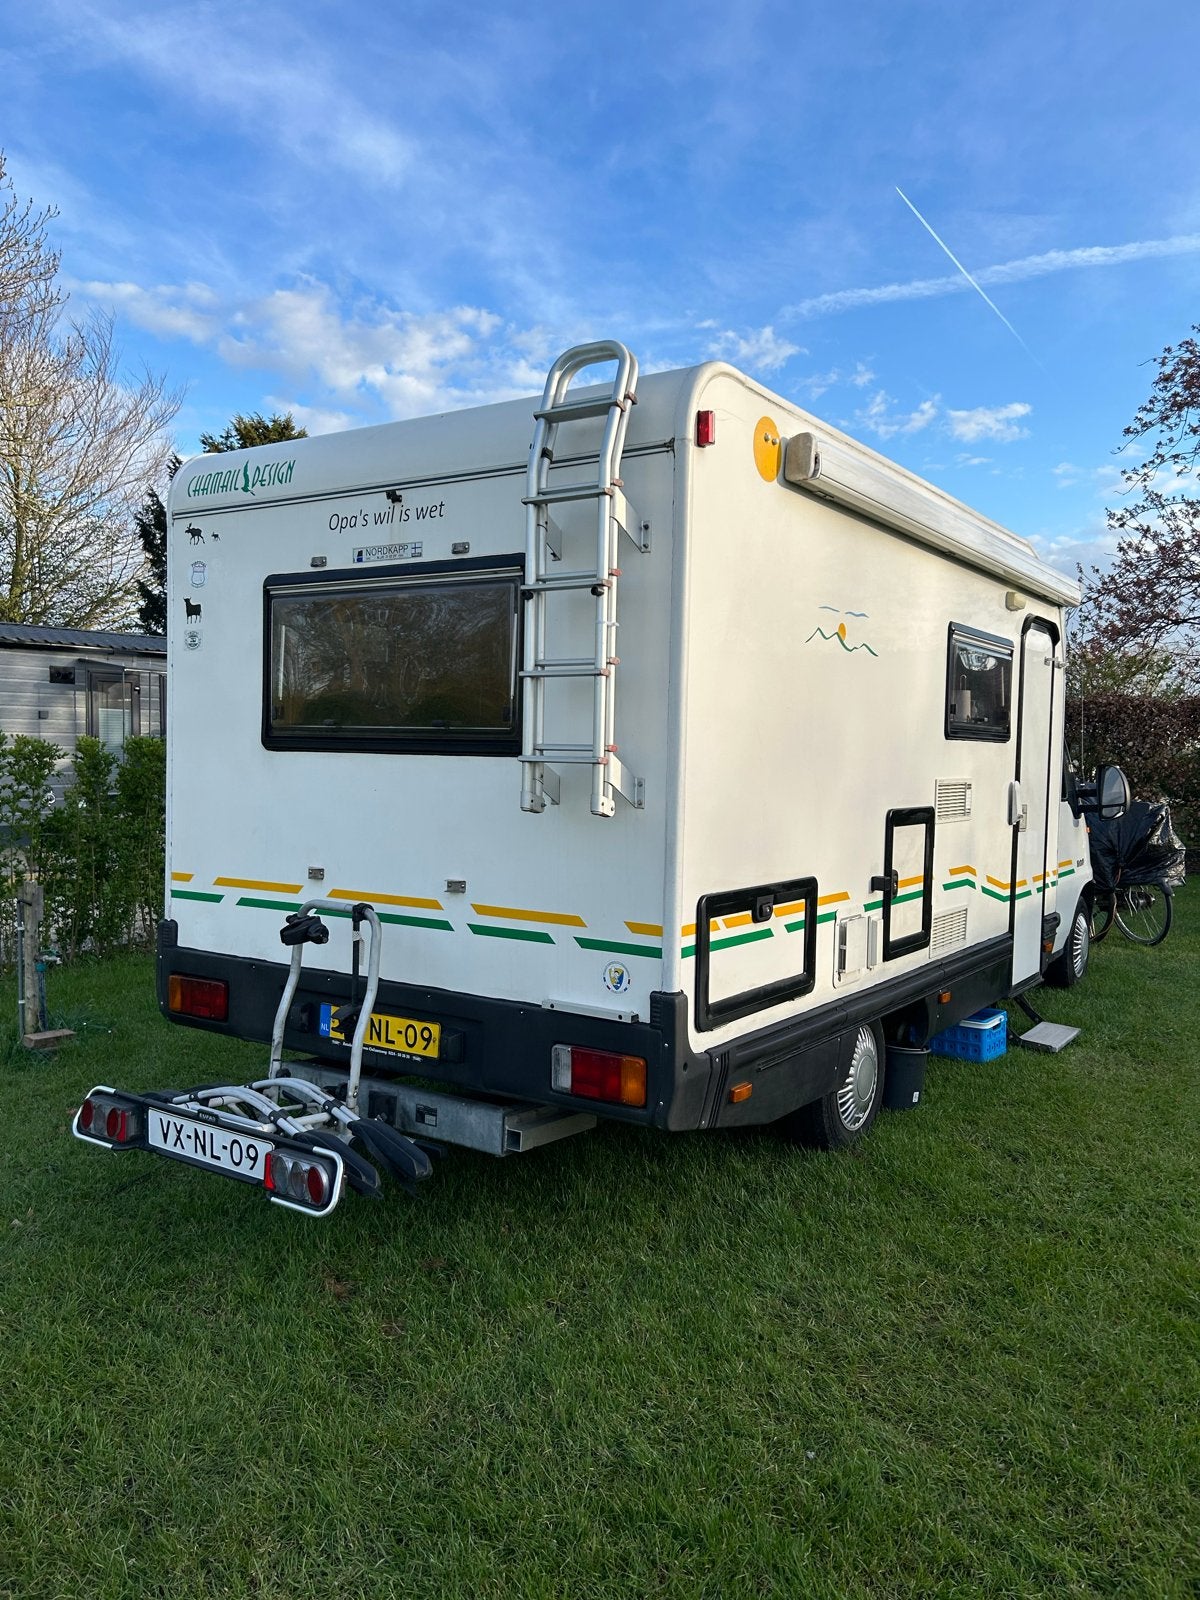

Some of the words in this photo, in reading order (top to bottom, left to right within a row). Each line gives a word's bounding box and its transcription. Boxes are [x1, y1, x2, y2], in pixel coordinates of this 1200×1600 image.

[187, 468, 241, 498] CHAMAIL
[251, 459, 297, 489] DESIGN
[328, 508, 369, 534] Opa's
[373, 504, 396, 526] wil
[399, 504, 411, 523] is
[415, 500, 446, 521] wet
[365, 544, 409, 557] NORDKAPP
[320, 1022, 330, 1032] NL
[159, 1116, 259, 1171] VX-NL-09
